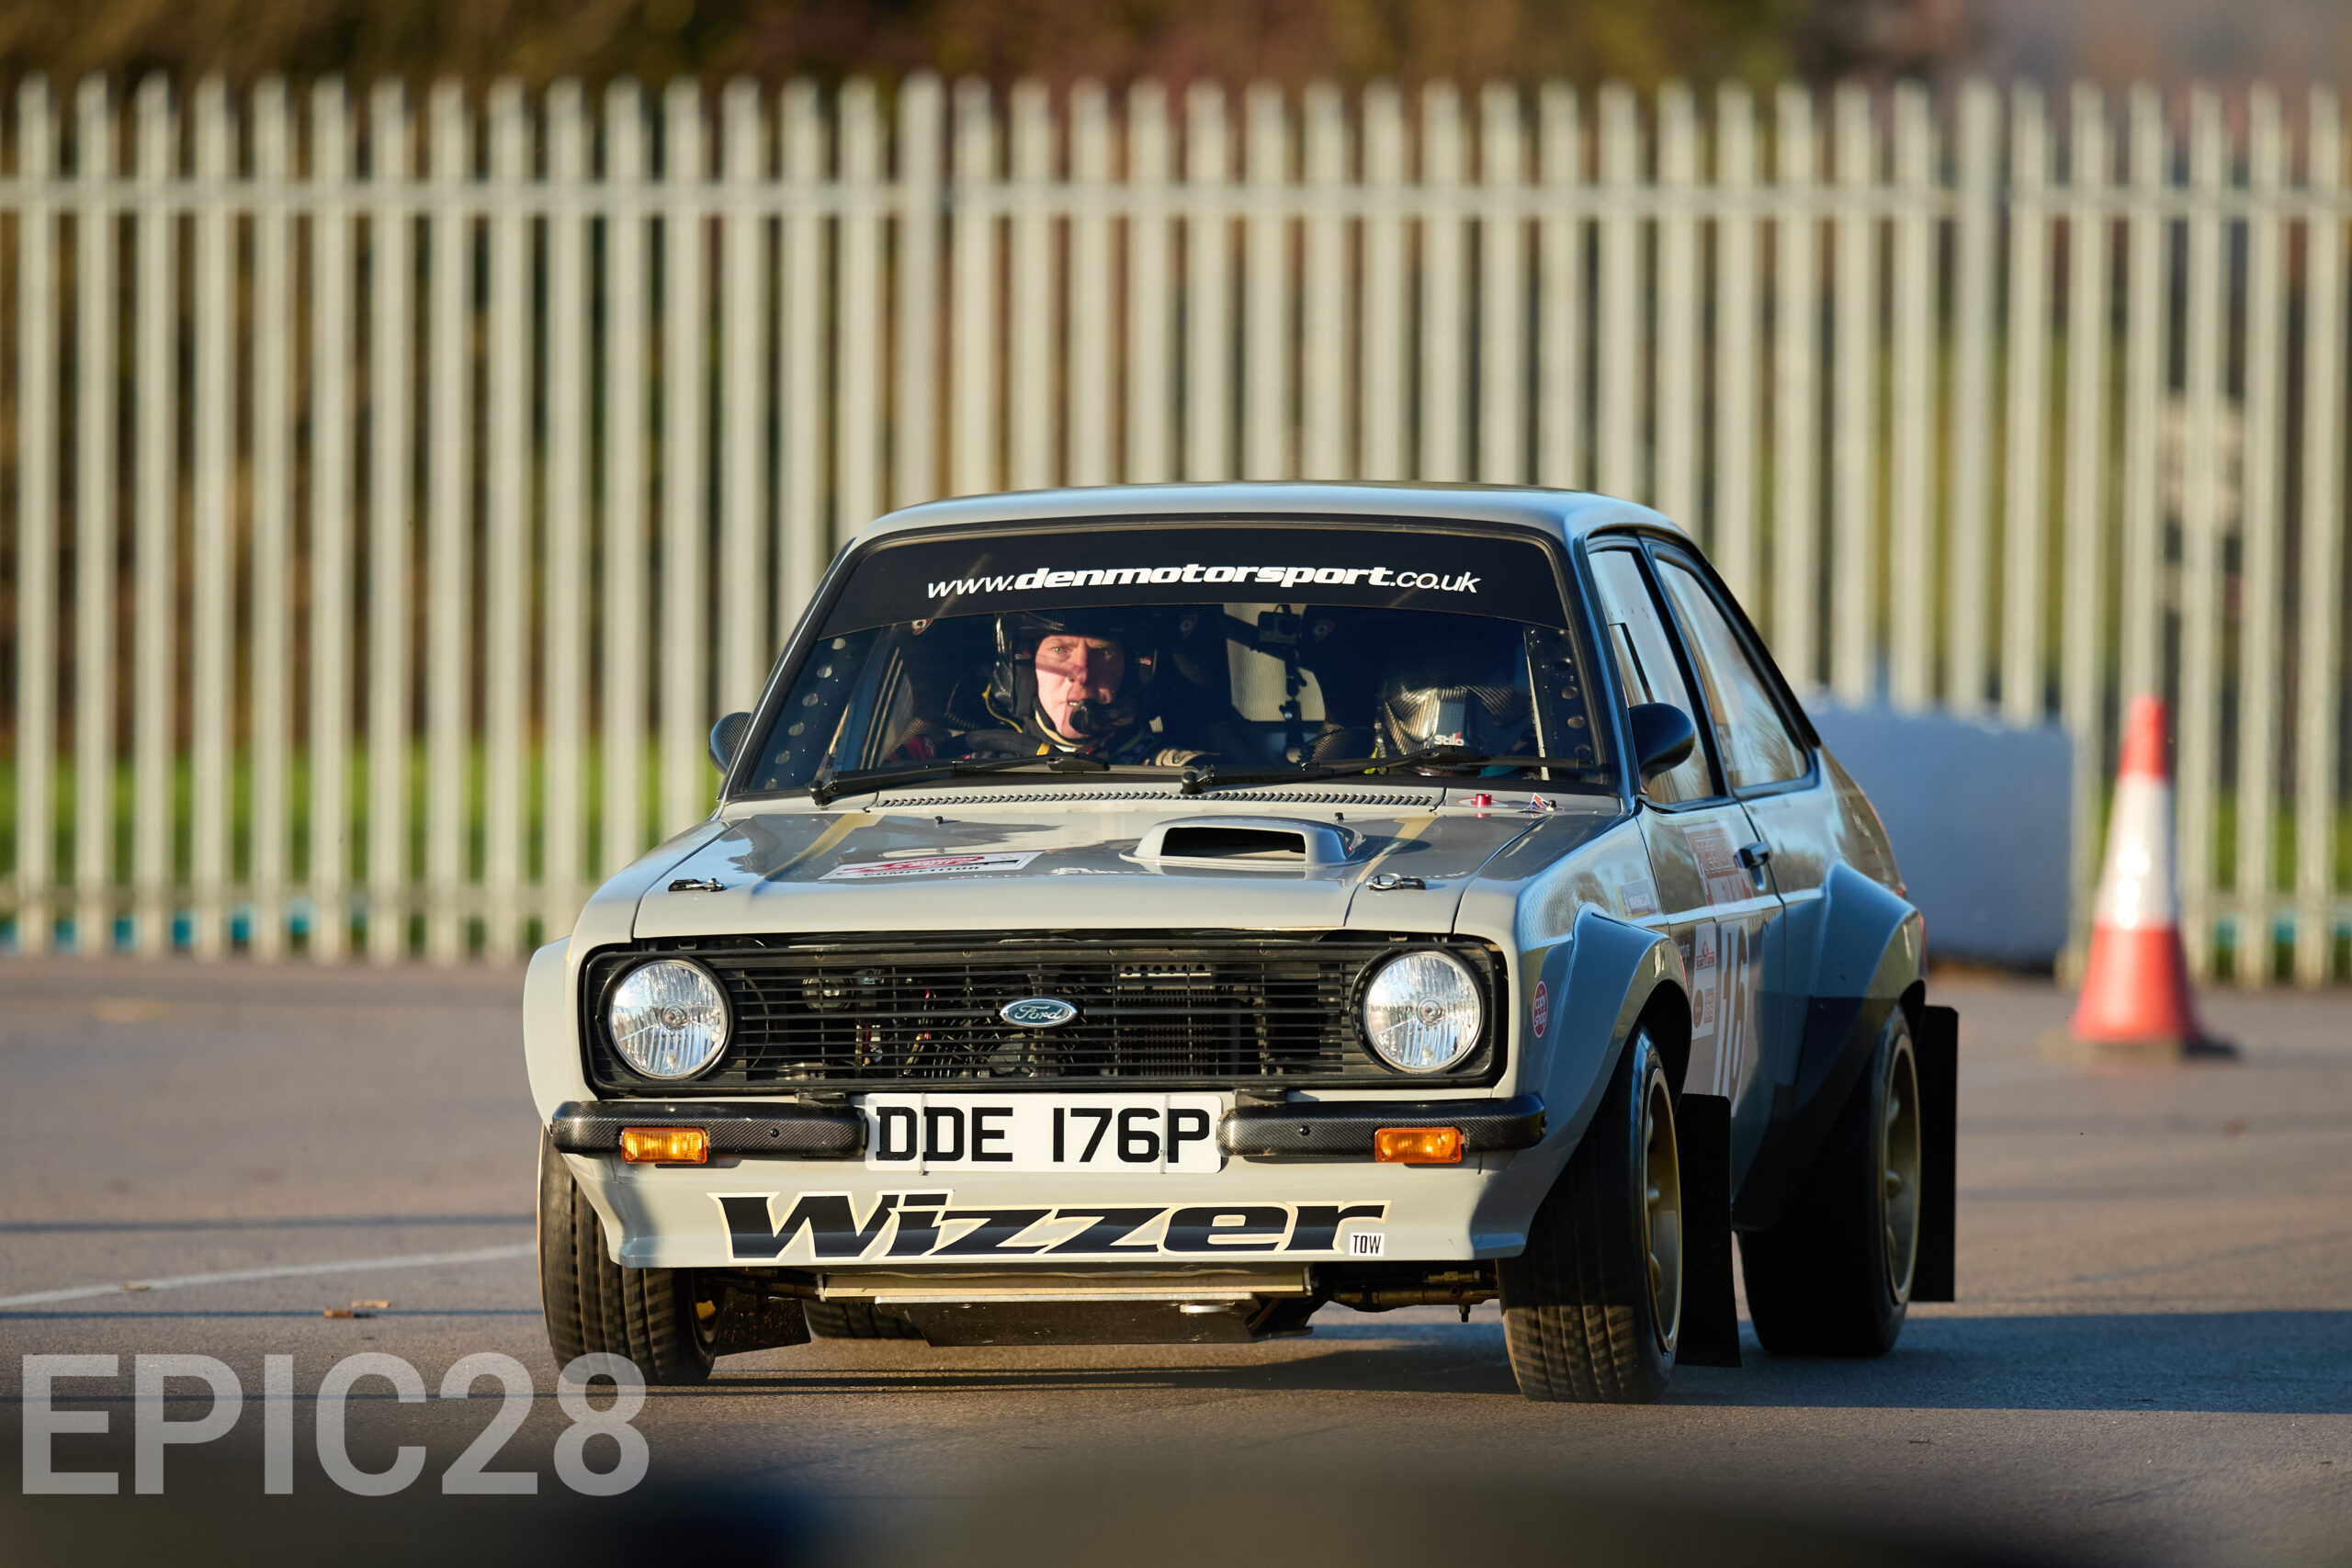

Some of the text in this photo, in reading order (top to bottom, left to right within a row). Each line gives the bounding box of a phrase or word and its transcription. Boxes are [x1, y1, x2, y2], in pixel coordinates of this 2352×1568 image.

[927, 563, 1482, 600] www.denmotorsport.co.uk
[1433, 731, 1464, 747] Stilo
[1013, 1005, 1063, 1020] Ford
[875, 1106, 1210, 1163] DDE 176P
[709, 1190, 1389, 1262] Wizzer
[1352, 1235, 1382, 1254] TOW
